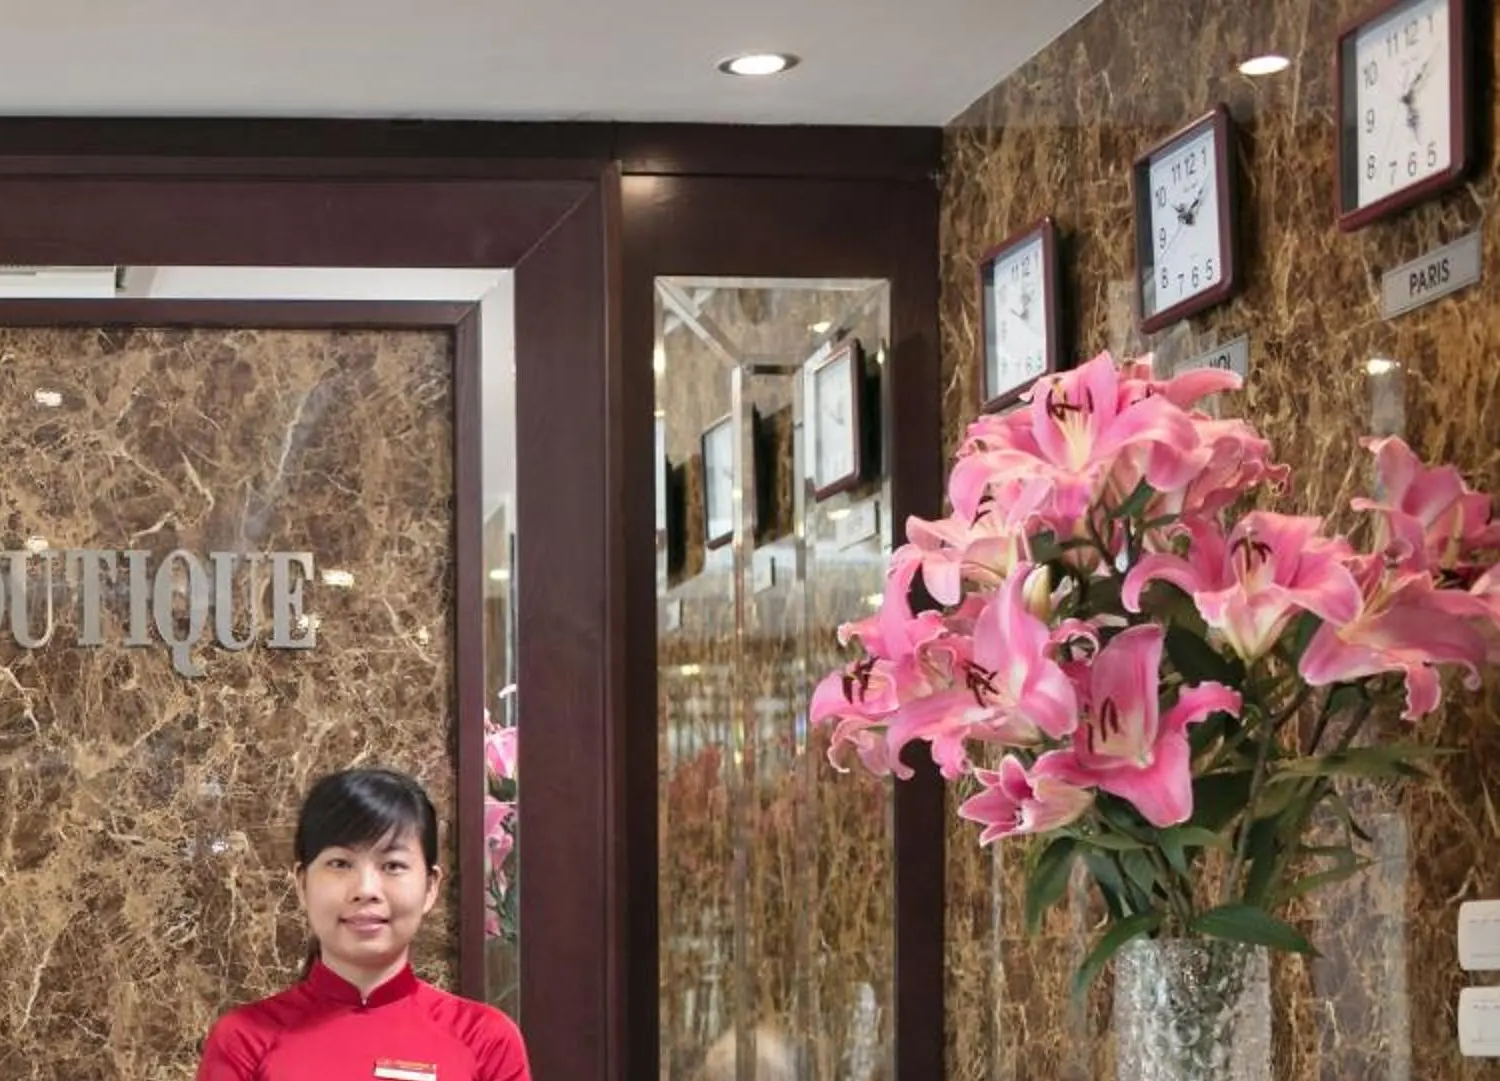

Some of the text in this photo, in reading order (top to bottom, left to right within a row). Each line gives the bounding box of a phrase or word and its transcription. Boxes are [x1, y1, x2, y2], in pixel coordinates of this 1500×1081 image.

[1386, 30, 1399, 58] 11
[1404, 19, 1419, 46] 12
[1363, 60, 1378, 90] 10
[1365, 108, 1375, 134] 9
[1184, 153, 1196, 176] 12
[1407, 151, 1417, 178] 6
[1427, 140, 1437, 168] 5
[1171, 163, 1182, 187] 11
[1366, 154, 1376, 181] 8
[1388, 159, 1398, 187] 7
[1155, 185, 1167, 208] 10
[1159, 227, 1167, 250] 9
[1161, 266, 1169, 290] 8
[1191, 265, 1200, 289] 6
[1205, 258, 1214, 281] 5
[1408, 258, 1450, 298] PARIS
[1177, 272, 1185, 296] 7
